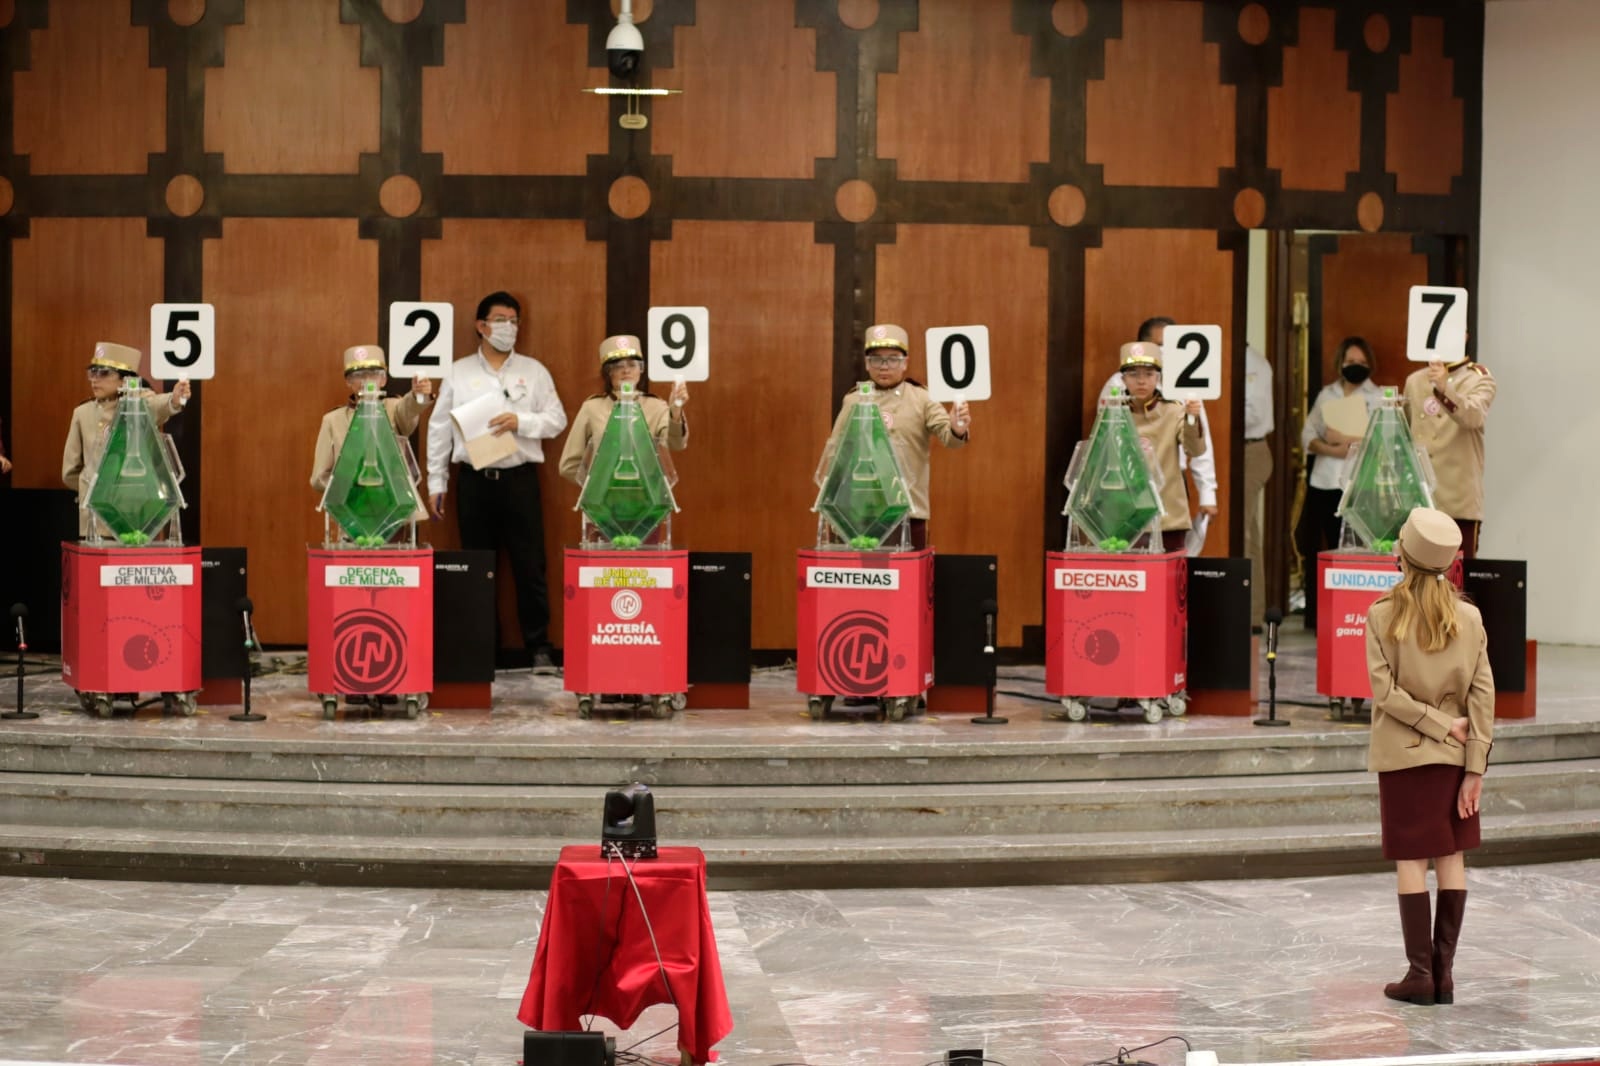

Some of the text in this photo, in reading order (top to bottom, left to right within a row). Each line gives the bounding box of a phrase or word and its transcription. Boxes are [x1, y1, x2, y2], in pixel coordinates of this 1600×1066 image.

[1421, 293, 1456, 349] 7
[163, 310, 202, 367] 5
[402, 309, 441, 366] 2
[661, 313, 696, 369] 9
[940, 333, 976, 389] 0
[1174, 332, 1210, 388] 2
[118, 567, 174, 577] CENTENA
[346, 567, 398, 577] DECENA
[814, 571, 892, 586] CENTENAS
[115, 575, 177, 585] DE MILLAR
[339, 575, 405, 585] DE MILLAR
[594, 577, 610, 587] DE
[1062, 572, 1139, 588] DECENAS
[1331, 573, 1404, 588] UNIDADE
[597, 621, 655, 634] LOTERÍA
[1336, 627, 1364, 637] gana
[591, 634, 661, 645] NACIONAL
